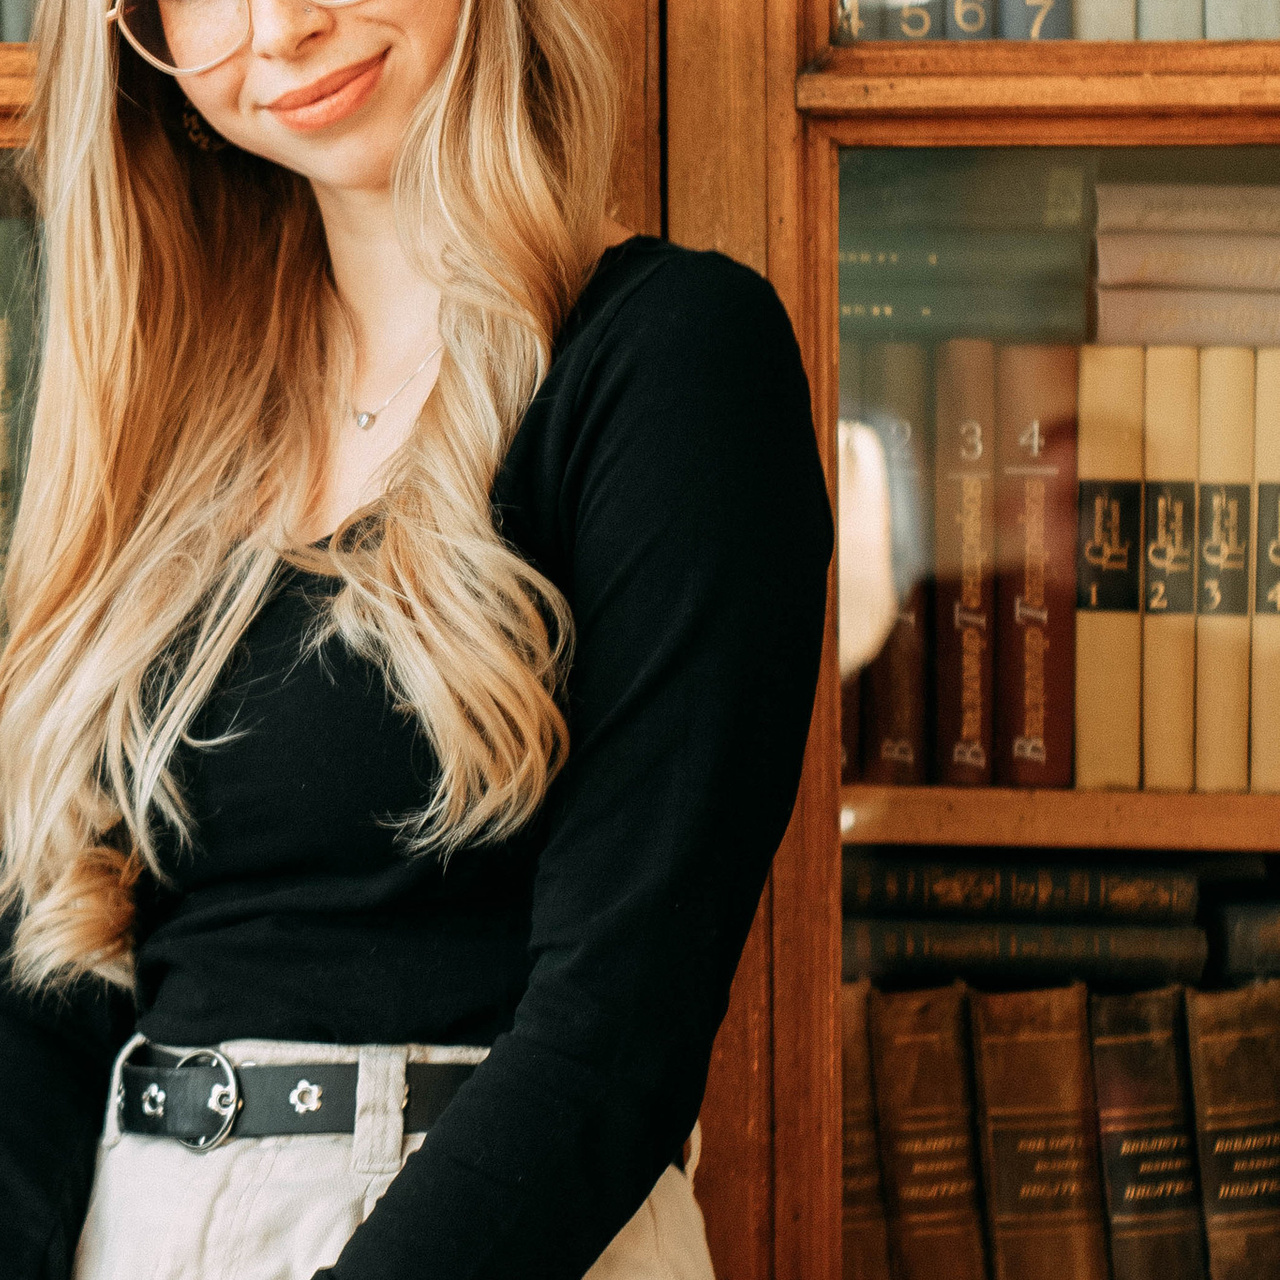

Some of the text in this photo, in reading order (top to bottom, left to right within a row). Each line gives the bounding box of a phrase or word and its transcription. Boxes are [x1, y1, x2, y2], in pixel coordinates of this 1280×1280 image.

[960, 422, 983, 460] 3
[1018, 419, 1044, 458] 4
[1088, 584, 1097, 605] 1
[1149, 581, 1168, 609] 2
[1203, 580, 1221, 609] 3
